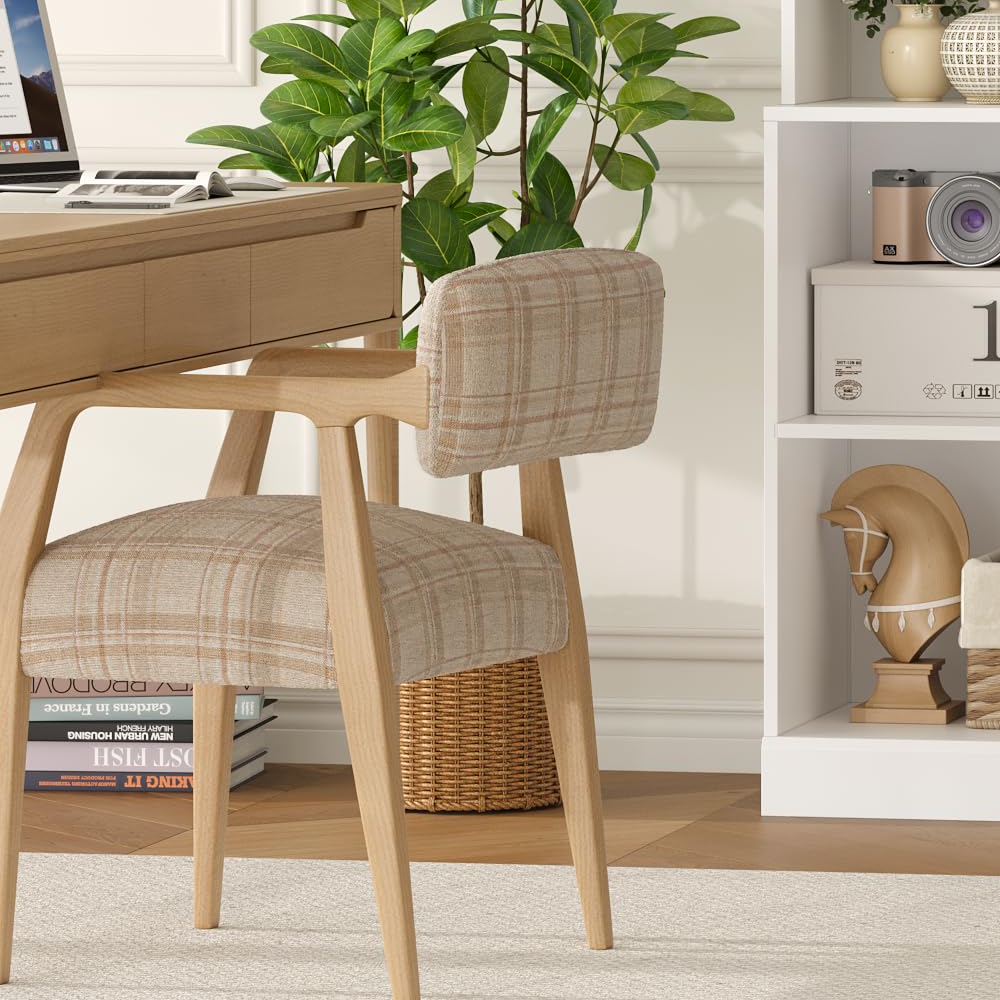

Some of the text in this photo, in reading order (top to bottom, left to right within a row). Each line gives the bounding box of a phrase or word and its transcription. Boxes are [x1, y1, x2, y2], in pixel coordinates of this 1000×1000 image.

[43, 702, 172, 716] Gardens in France
[116, 724, 174, 732] HILARY FRENCH
[67, 731, 174, 741] NEW URBAN HOUSING
[92, 747, 146, 767] FISH
[123, 775, 143, 788] IT
